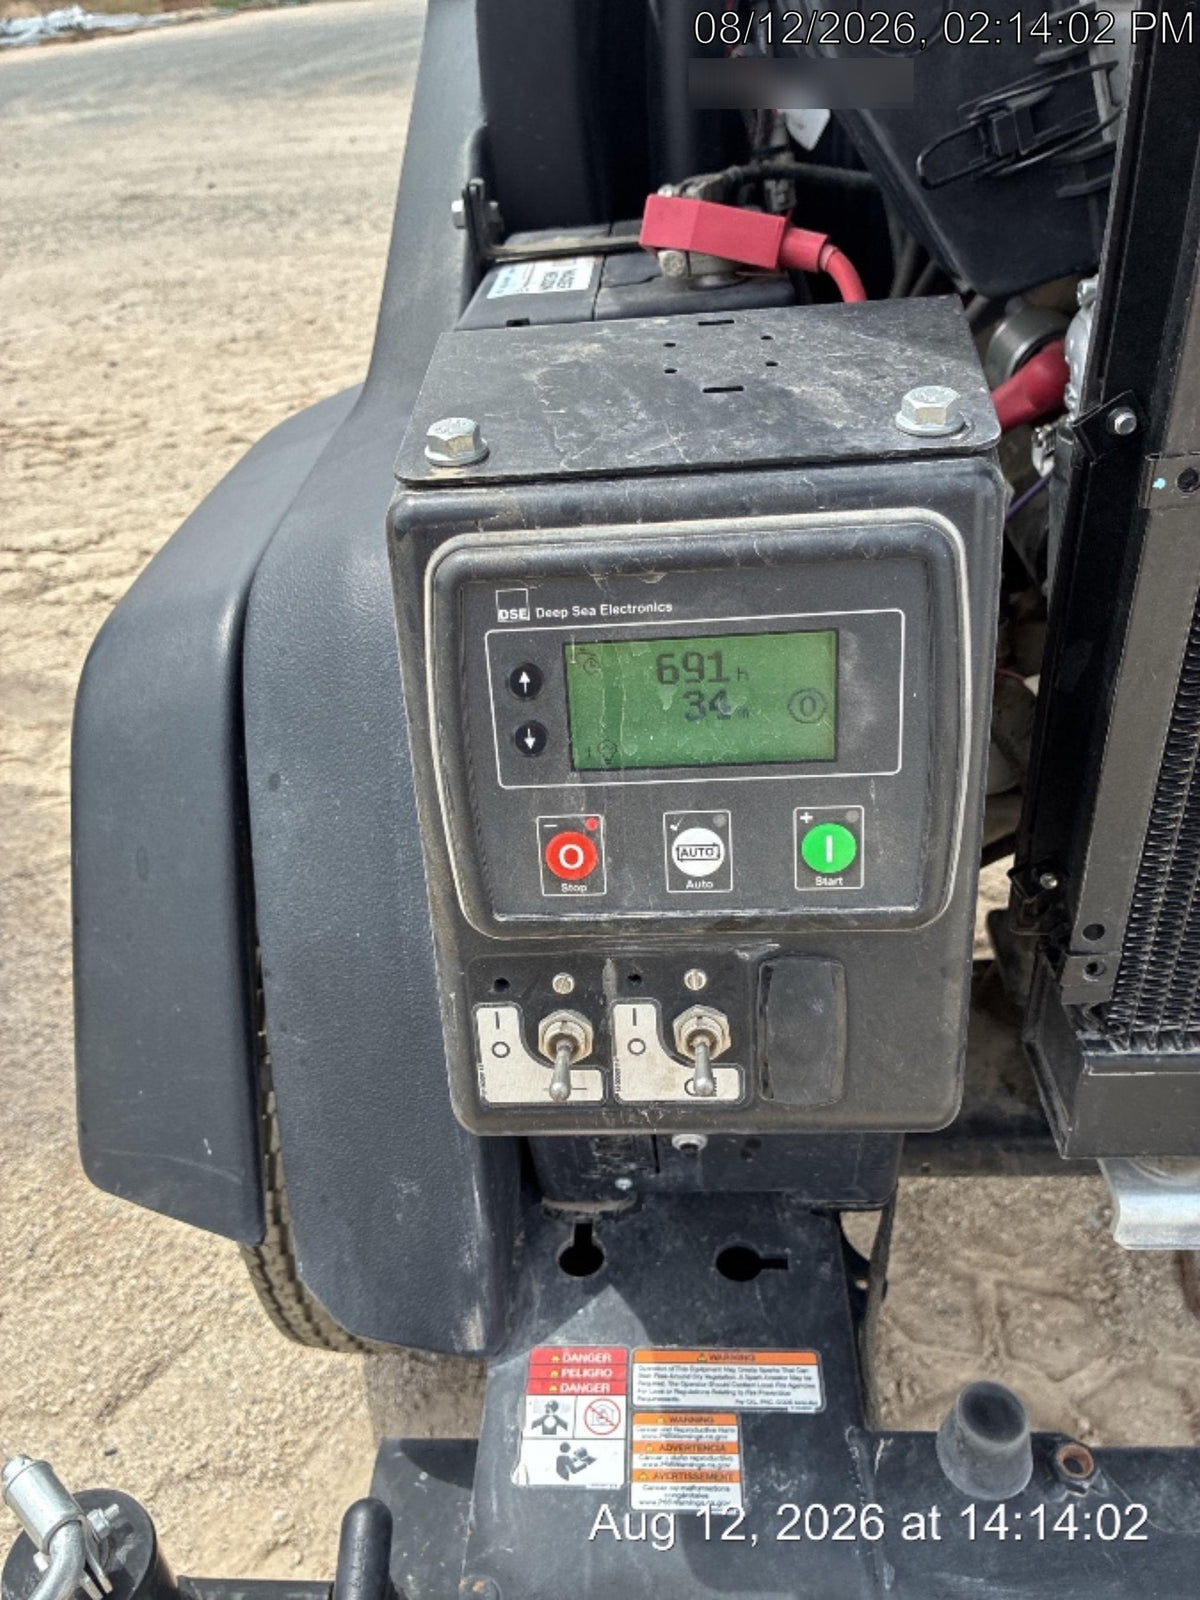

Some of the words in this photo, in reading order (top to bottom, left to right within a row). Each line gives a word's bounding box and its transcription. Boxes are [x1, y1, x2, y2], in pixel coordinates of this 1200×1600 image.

[498, 608, 528, 620] DSE
[536, 607, 568, 619] Deep
[572, 605, 597, 616] Sea
[600, 602, 673, 615] Electronics
[656, 651, 731, 685] 691
[683, 689, 732, 722] 34
[680, 847, 714, 858] AUTO
[686, 879, 714, 890] Auto
[816, 876, 844, 886] Start
[561, 883, 588, 893] Stop
[562, 1352, 612, 1363] DANGER
[709, 1352, 756, 1362] WARNING
[561, 1368, 613, 1377] PELIGRO
[560, 1383, 611, 1393] DANGER
[659, 1443, 727, 1451] ADVERTENCIA
